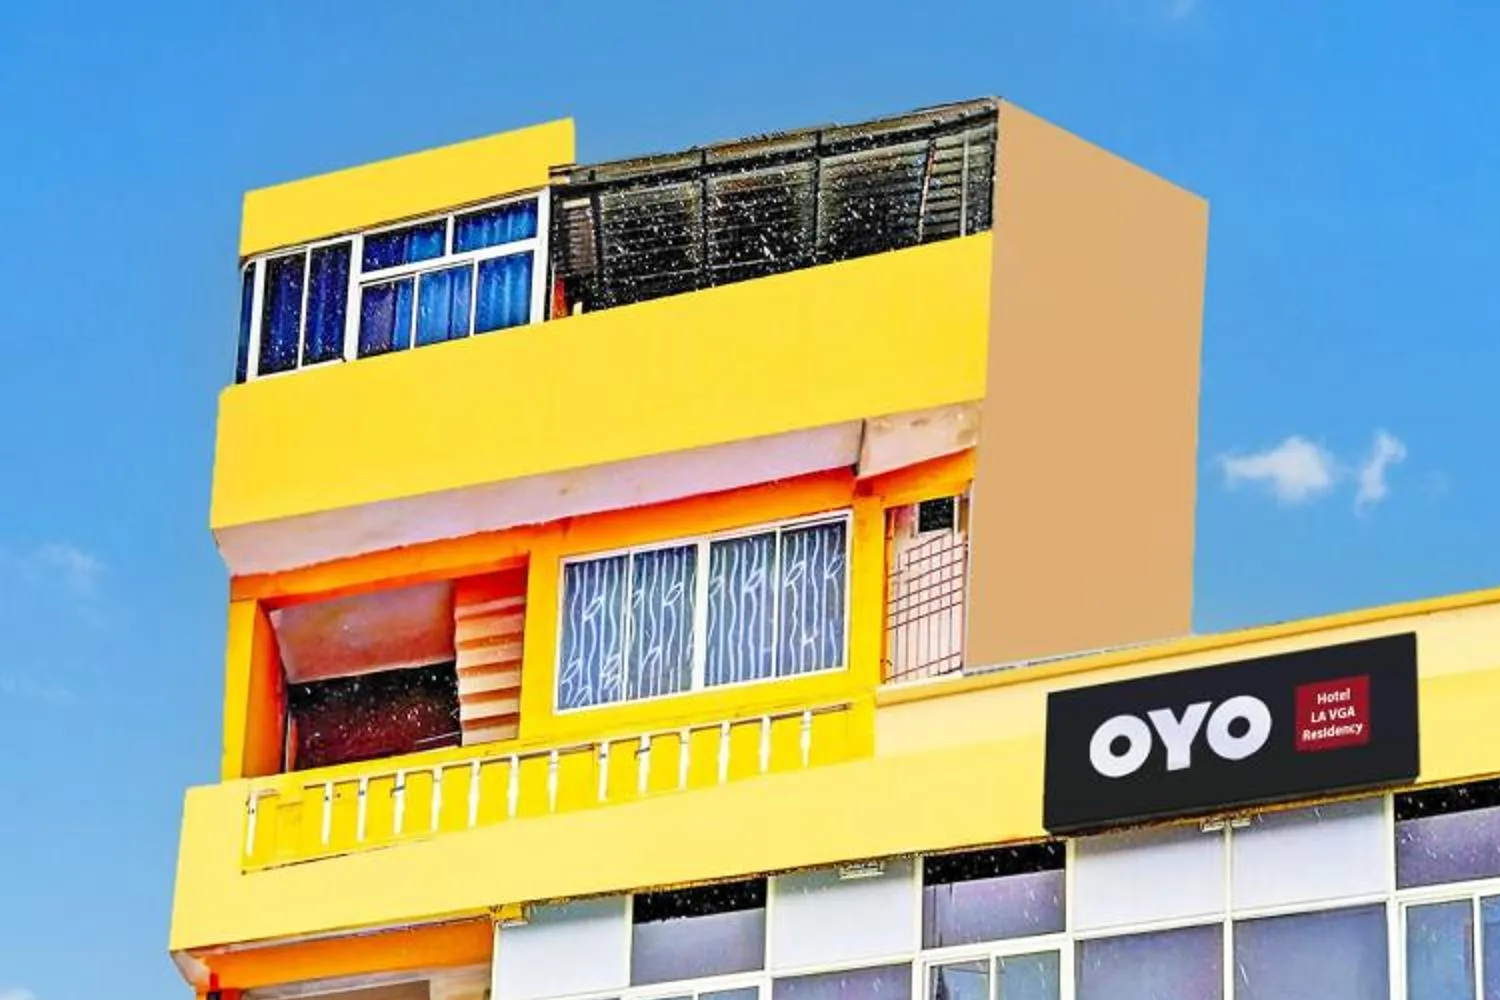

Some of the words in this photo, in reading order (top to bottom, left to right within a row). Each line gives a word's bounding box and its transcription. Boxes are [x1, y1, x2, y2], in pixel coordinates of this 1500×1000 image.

[1317, 687, 1351, 705] Hotel
[1311, 710, 1326, 724] LA
[1328, 706, 1356, 722] VGA
[1089, 695, 1272, 778] OYO
[1302, 721, 1363, 742] Residency
